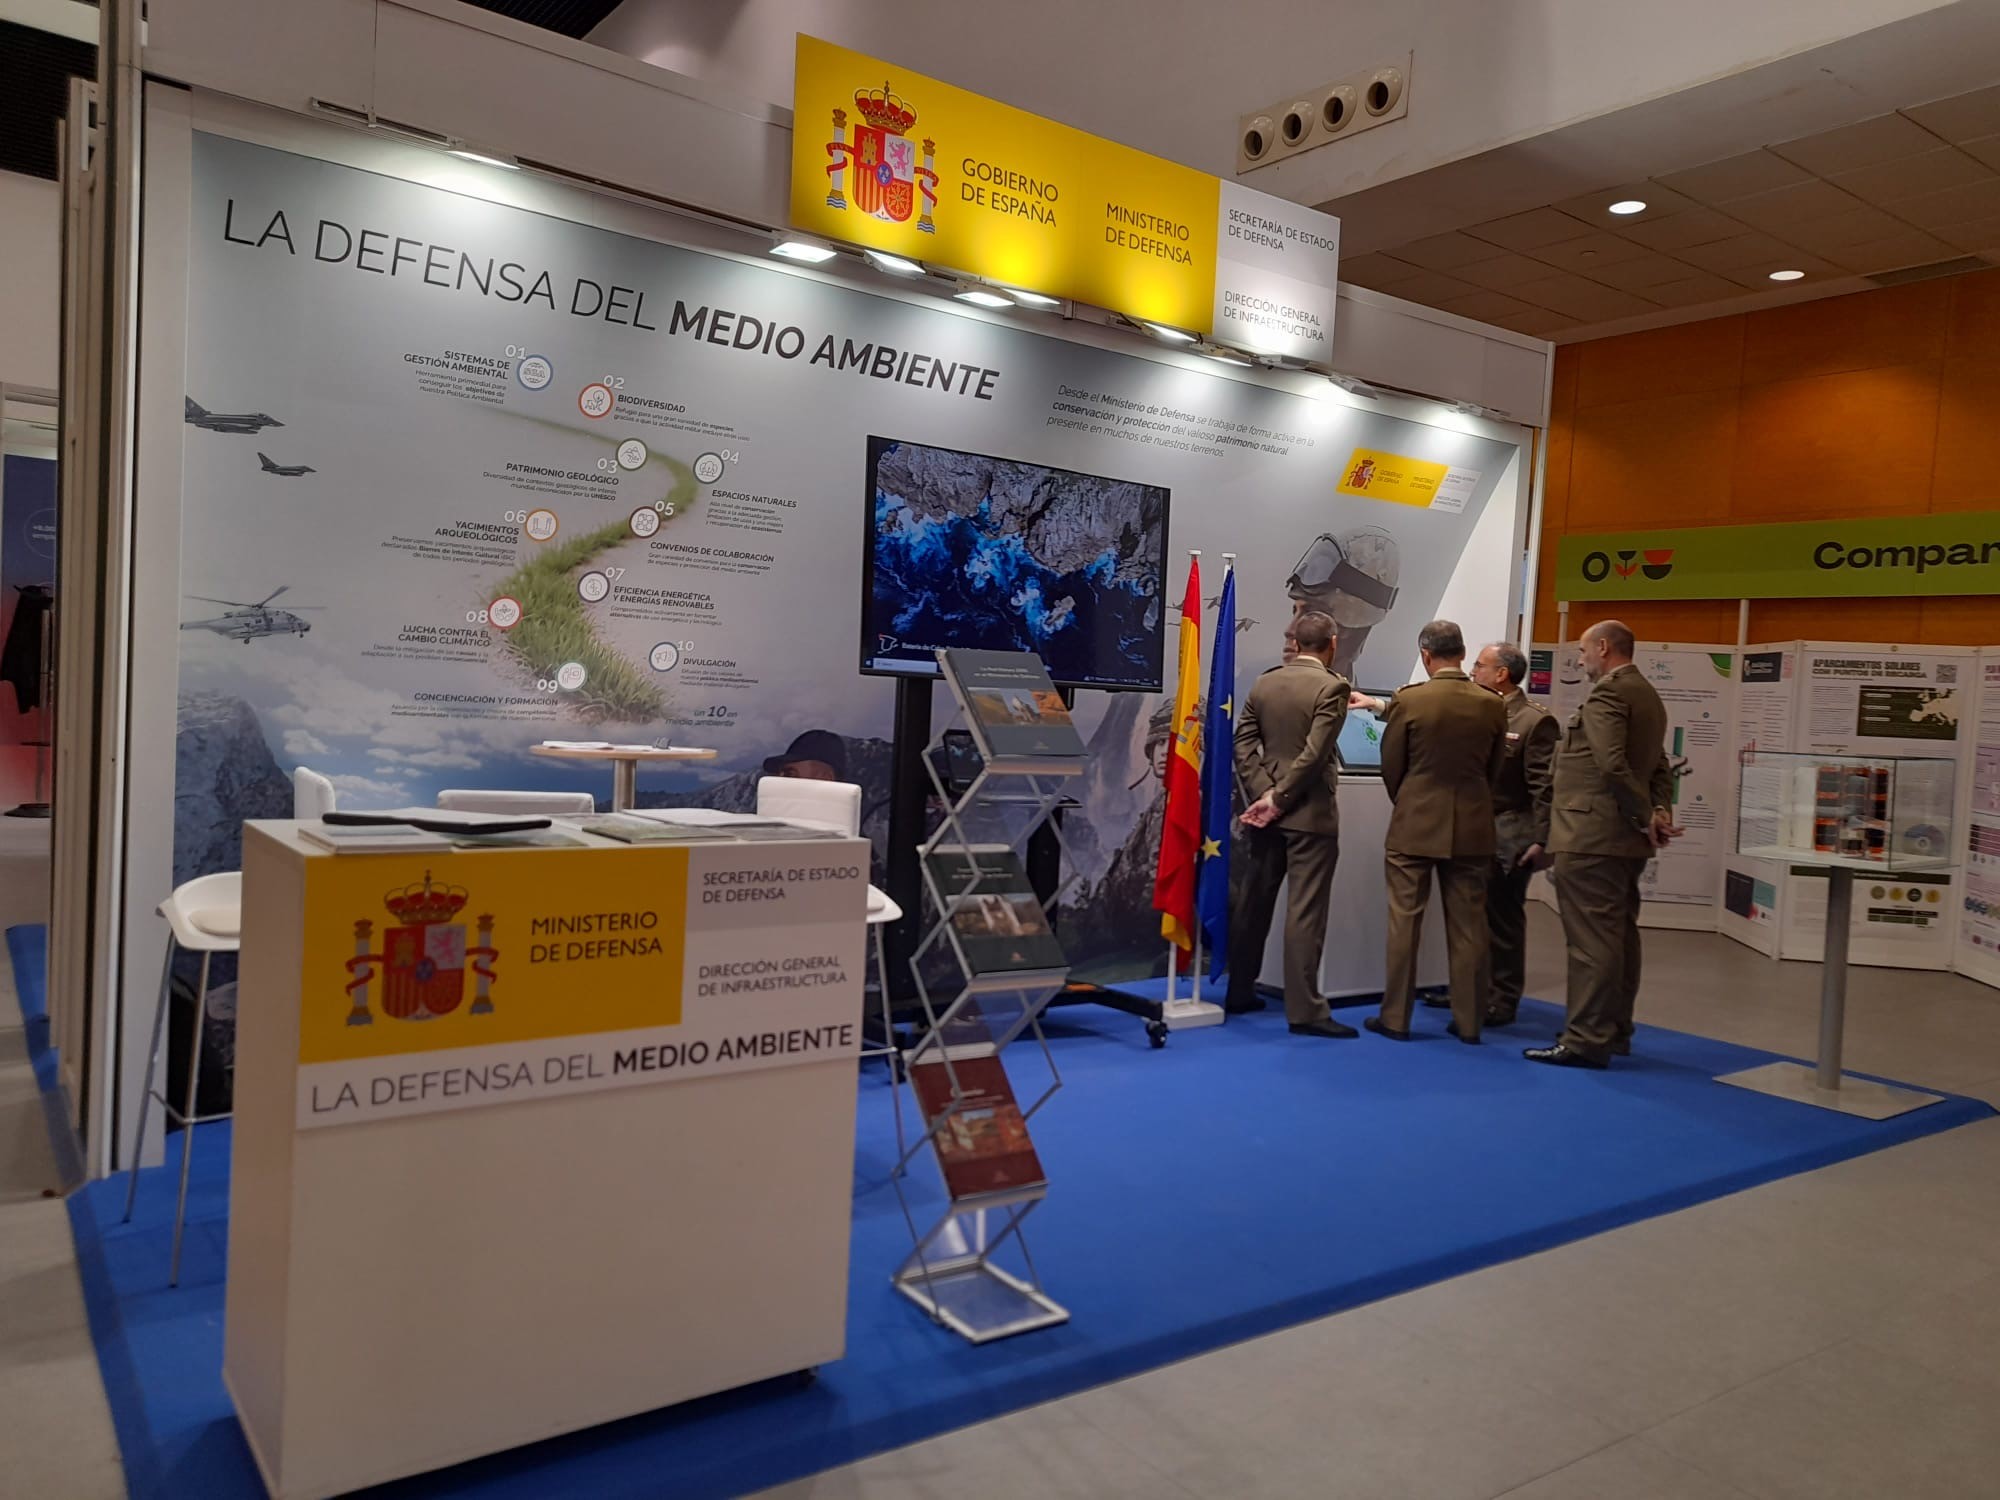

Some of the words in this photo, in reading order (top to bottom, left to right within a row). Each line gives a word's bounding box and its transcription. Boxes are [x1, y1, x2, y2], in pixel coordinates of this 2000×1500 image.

[962, 158, 1059, 202] GOBIERNO
[962, 183, 985, 206] DE
[991, 191, 1056, 228] ESPAÑA
[1107, 202, 1189, 241] MINISTERIO
[1229, 208, 1282, 235] SECRETARÍA
[1286, 224, 1297, 240] DE
[1300, 230, 1334, 252] ESTADO
[1106, 226, 1124, 247] DE
[1129, 231, 1192, 266] DEFENSA
[1228, 225, 1240, 238] DE
[1243, 229, 1284, 252] DEFENSA
[225, 199, 295, 255] LA
[315, 219, 555, 310] DEFENSA
[571, 279, 655, 330] DEL
[669, 300, 805, 359] MEDIO
[810, 335, 1000, 401] AMBIENTE
[1225, 290, 1278, 315] DIRECCIÓN
[1281, 306, 1320, 326] GENERAL
[1223, 305, 1236, 319] DE
[1239, 309, 1324, 341] INFRAESTRUCTURA
[444, 351, 494, 367] SISTEMAS
[497, 360, 510, 370] DE
[505, 345, 526, 360] 01
[404, 354, 449, 369] GESTIÓN
[451, 362, 508, 379] AMBIENTAL
[604, 375, 624, 389] 02
[618, 394, 685, 413] BIODIVERSIDAD
[1058, 384, 1088, 400] Desde
[1090, 392, 1098, 402] el
[1100, 394, 1145, 412] Ministerio
[1147, 404, 1158, 416] de
[1160, 406, 1195, 422] Defensa
[1197, 416, 1206, 424] se
[1208, 416, 1235, 432] trabaja
[1236, 422, 1247, 433] de
[1249, 424, 1271, 439] forma
[1047, 416, 1088, 432] presente
[1090, 424, 1102, 434] en
[1104, 426, 1138, 442] muchos
[1140, 432, 1152, 444] de
[1154, 436, 1189, 451] nuestros
[1052, 400, 1114, 421] conservación
[1116, 414, 1122, 425] y
[1123, 416, 1170, 434] protección
[1172, 424, 1186, 436] del
[1187, 427, 1214, 442] valioso
[1215, 432, 1259, 450] patrimonio
[1260, 442, 1288, 456] natural
[598, 458, 618, 474] 03
[721, 449, 740, 464] 04
[506, 462, 564, 478] PATRIMONIO
[567, 471, 619, 485] GEOLÓGICO
[655, 501, 675, 516] 05
[712, 490, 750, 501] ESPACIOS
[752, 496, 797, 508] NATURALES
[505, 510, 526, 524] 06
[435, 528, 518, 544] ARQUEOLÓGICOS
[456, 521, 519, 535] YACIMIENTOS
[651, 542, 698, 553] CONVENIOS
[700, 547, 711, 555] DE
[713, 548, 774, 562] COLABORACIÓN
[605, 567, 626, 582] 07
[614, 586, 659, 597] EFICIENCIA
[661, 589, 711, 601] ENERGÉTICA
[620, 595, 660, 605] ENERGÍAS
[662, 600, 714, 610] RENOVABLES
[466, 610, 488, 623] 08
[399, 634, 437, 643] CAMBIO
[439, 636, 490, 647] CLIMÁTICO
[403, 625, 436, 634] LUCHA
[439, 627, 477, 637] CONTRA
[677, 640, 694, 651] 10
[684, 658, 736, 668] DIVULGACIÓN
[537, 679, 558, 693] 09
[415, 693, 495, 704] CONCIENCIACIÓN
[505, 697, 558, 706] FORMACIÓN
[708, 706, 727, 717] 10
[703, 868, 784, 885] SECRETARÍA
[788, 868, 806, 882] DE
[809, 866, 859, 881] ESTADO
[703, 889, 722, 903] DE
[725, 886, 785, 901] DEFENSA
[531, 910, 658, 936] MINISTERIO
[530, 942, 562, 964] DE
[566, 936, 663, 961] DEFENSA
[699, 960, 778, 980] DIRECCIÓN
[782, 955, 840, 973] GENERAL
[698, 982, 717, 997] DE
[721, 972, 847, 995] INFRAESTRUCTURA
[312, 1085, 358, 1113] LA
[370, 1063, 534, 1106] DEFENSA
[543, 1055, 603, 1085] DEL
[613, 1042, 709, 1075] MEDIO
[716, 1024, 853, 1062] AMBIENTE
